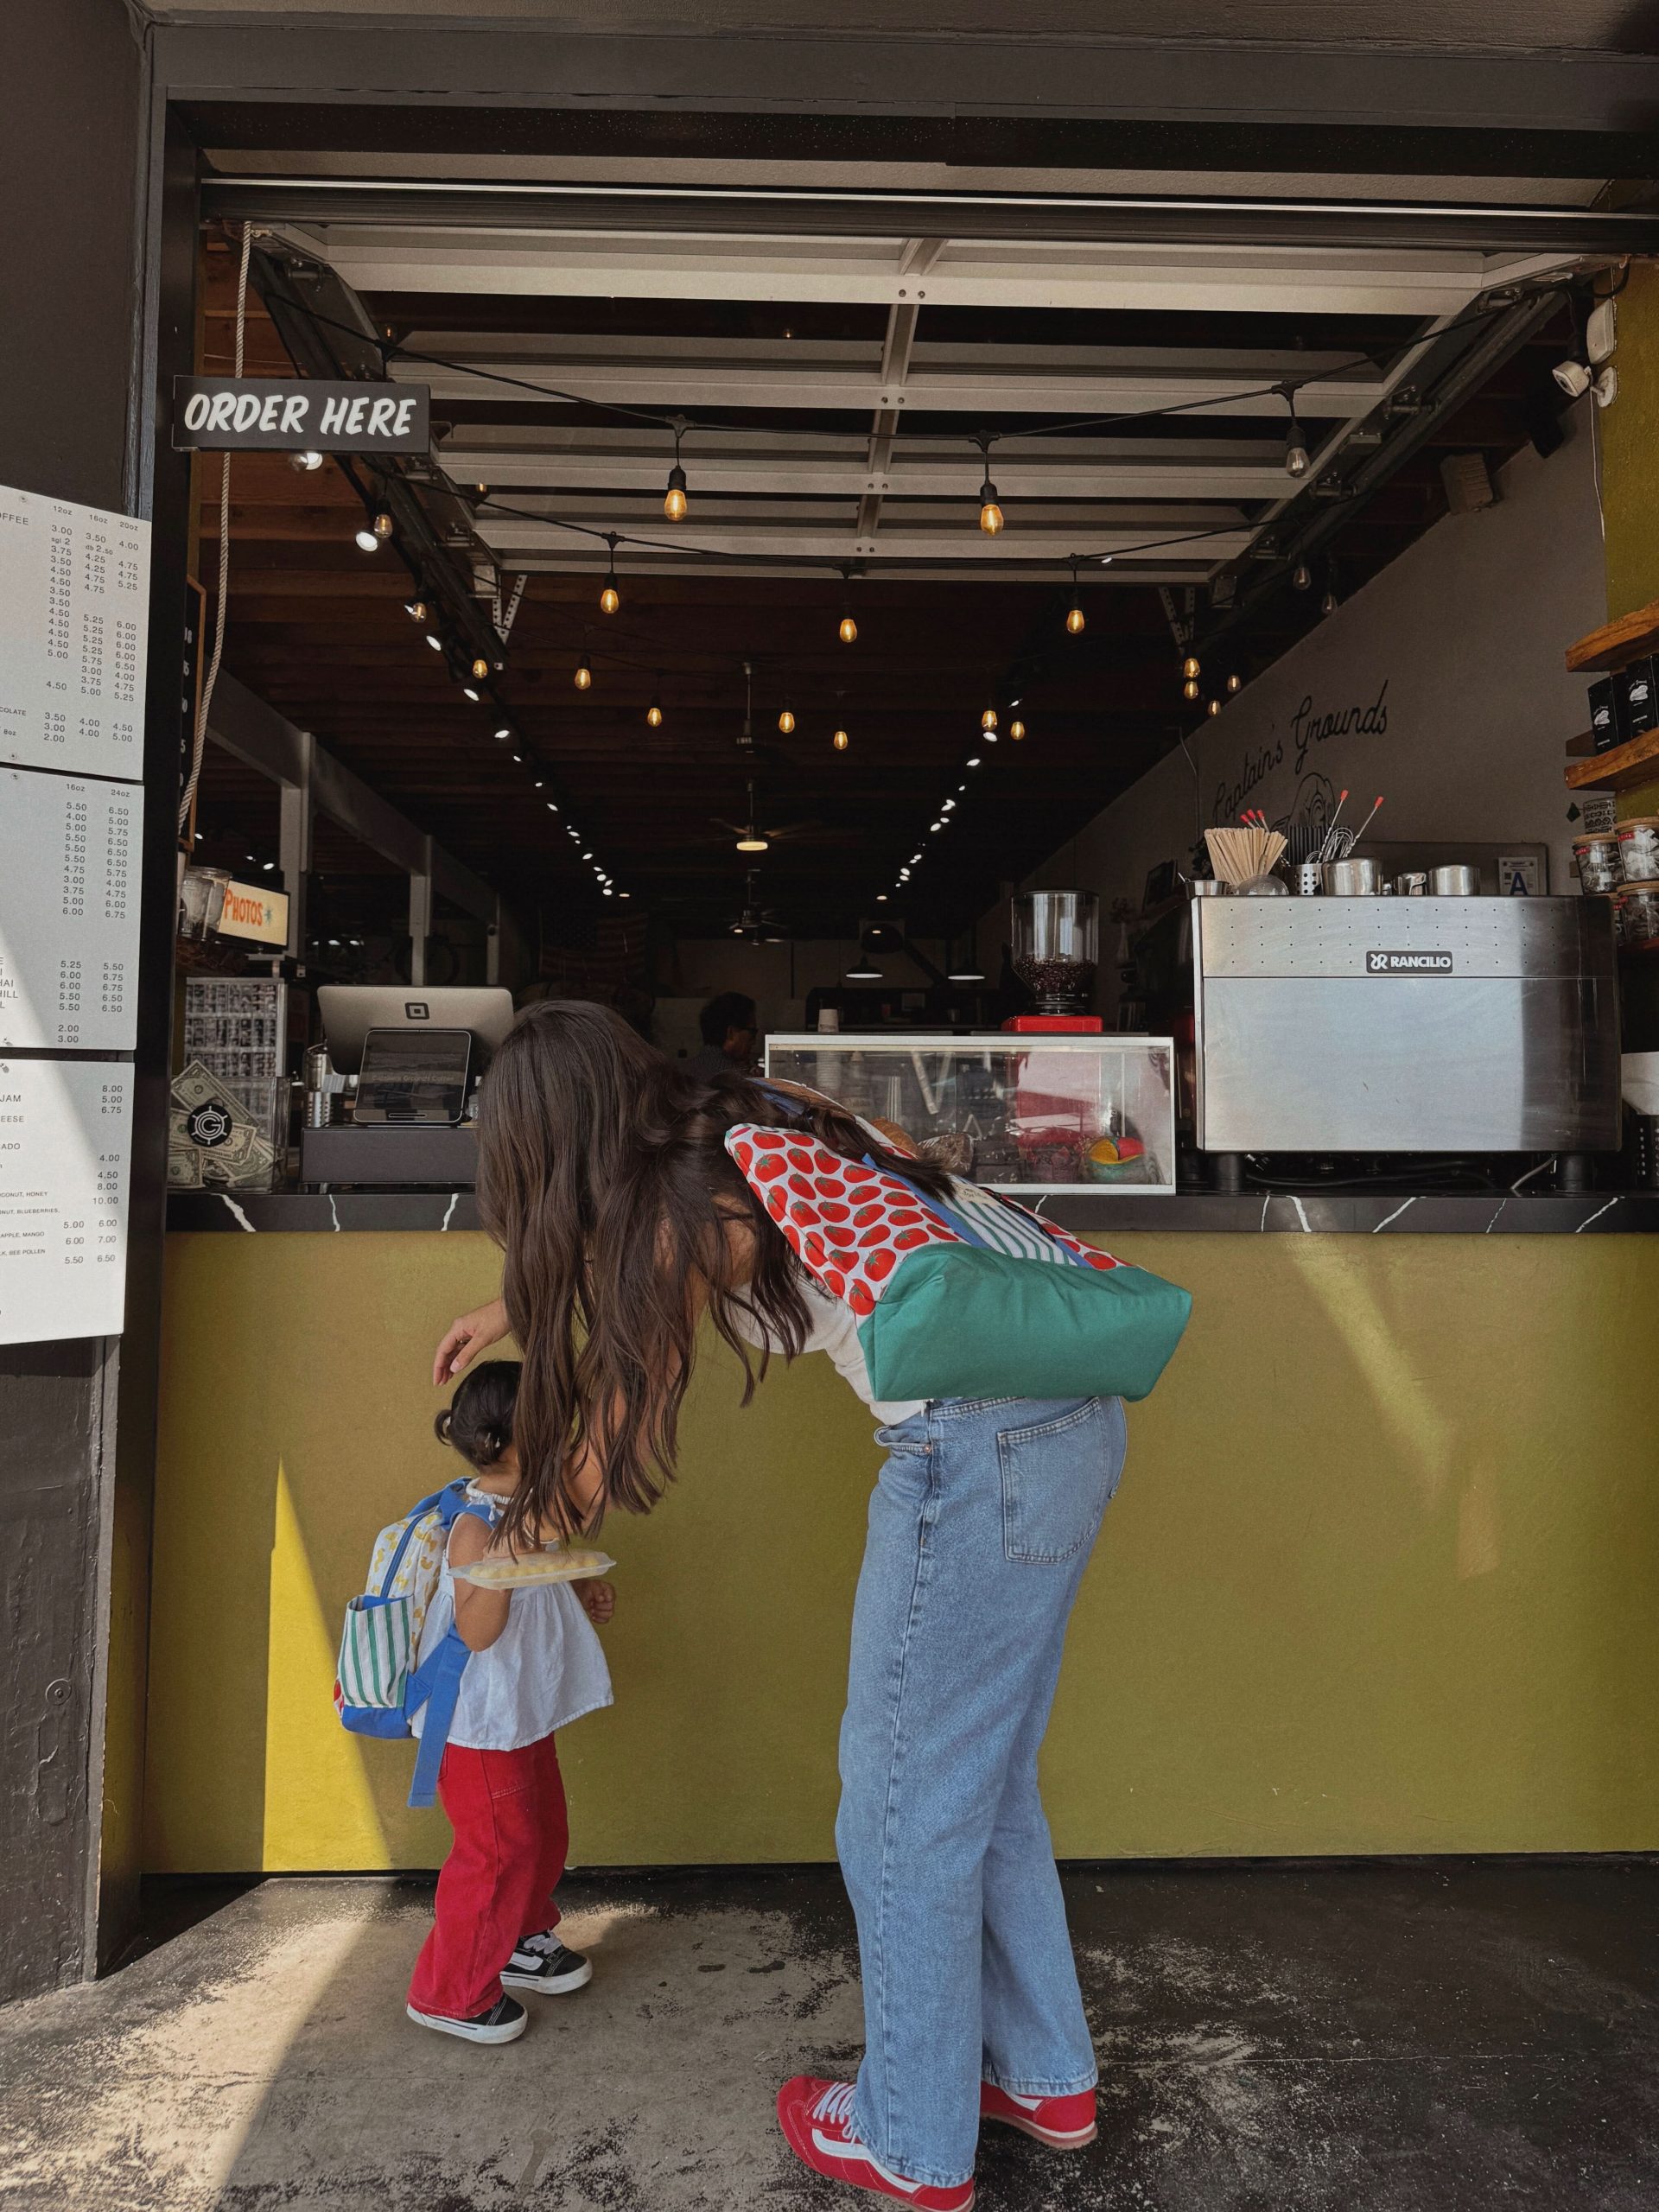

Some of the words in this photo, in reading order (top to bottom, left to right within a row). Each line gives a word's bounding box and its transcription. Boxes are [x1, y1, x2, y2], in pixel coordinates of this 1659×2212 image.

[184, 392, 309, 433] ORDER
[320, 397, 416, 437] HERE
[54, 505, 73, 516] 12oz
[119, 521, 138, 532] 20oz
[0, 512, 29, 525] FFEE
[52, 524, 73, 536] 3.00
[86, 532, 106, 543] 3.50
[119, 540, 139, 551] 4.00
[51, 544, 72, 556] 3.75
[85, 553, 105, 563] 4.25
[118, 561, 138, 571] 4.75
[50, 555, 72, 566] 3.50
[85, 563, 105, 574] 4.25
[118, 570, 138, 581] 4.75
[50, 566, 72, 577] 4.50
[85, 574, 105, 584] 4.75
[118, 580, 138, 591] 5.25
[50, 576, 71, 588] 4.50
[85, 584, 105, 594] 4.75
[49, 586, 71, 597] 3.50
[49, 596, 71, 608] 3.50
[48, 607, 70, 619] 4.50
[83, 613, 104, 625] 5.25
[117, 621, 137, 632] 6.00
[48, 618, 70, 629] 4.50
[83, 624, 104, 635] 5.25
[116, 631, 137, 641] 6.00
[48, 628, 69, 639] 4.50
[83, 634, 104, 645] 5.25
[116, 641, 137, 652] 6.00
[48, 639, 69, 650] 4.50
[83, 644, 103, 655] 5.25
[116, 652, 136, 662] 6.00
[48, 649, 69, 659] 5.00
[82, 655, 103, 665] 5.75
[115, 661, 135, 671] 6.50
[81, 665, 102, 676] 3.00
[114, 672, 135, 682] 4.00
[81, 676, 102, 686] 3.75
[114, 682, 135, 692] 4.75
[46, 681, 67, 691] 4.50
[80, 686, 102, 696] 5.00
[114, 691, 135, 702] 5.25
[45, 712, 66, 722] 3.50
[79, 717, 100, 728] 4.00
[112, 722, 133, 733] 4.50
[1290, 679, 1388, 776] Grounds
[43, 733, 65, 743] 2.00
[44, 722, 66, 733] 3.00
[79, 728, 100, 739] 4.00
[112, 733, 133, 743] 5.00
[66, 783, 86, 792] 16oz
[111, 789, 130, 798] 24oz
[66, 802, 87, 811] 5.50
[109, 806, 130, 816] 6.50
[66, 812, 87, 822] 4.00
[108, 817, 129, 826] 5.00
[65, 823, 86, 832] 5.00
[107, 827, 129, 836] 5.75
[65, 833, 86, 843] 5.50
[107, 837, 128, 847] 6.50
[65, 843, 86, 854] 5.50
[107, 848, 128, 857] 6.50
[64, 854, 86, 864] 5.50
[106, 858, 128, 868] 6.50
[64, 865, 85, 874] 4.75
[106, 868, 127, 878] 5.75
[63, 875, 85, 885] 3.00
[105, 880, 127, 888] 4.00
[1510, 872, 1528, 895] A
[63, 885, 85, 895] 3.75
[105, 889, 126, 899] 4.75
[62, 896, 84, 906] 5.00
[105, 899, 126, 909] 6.00
[62, 906, 84, 916] 6.00
[105, 910, 125, 919] 6.75
[60, 960, 82, 969] 5.25
[104, 963, 124, 971] 5.50
[1390, 957, 1452, 968] RANCILIO
[60, 971, 81, 980] 6.00
[103, 973, 124, 982] 6.75
[60, 982, 81, 990] 6.00
[102, 983, 123, 992] 6.75
[59, 992, 80, 1001] 5.50
[102, 994, 123, 1002] 6.50
[59, 1002, 80, 1011] 5.50
[102, 1004, 123, 1013] 6.50
[58, 1024, 79, 1033] 2.00
[57, 1035, 79, 1044] 3.00
[0, 1094, 22, 1103] JAM
[97, 1182, 118, 1191] 8.00
[92, 1196, 119, 1205] 10.00
[63, 1220, 85, 1229] 5.00
[99, 1219, 118, 1228] 6.00
[64, 1256, 84, 1265] 5.50
[97, 1255, 116, 1263] 6.50
